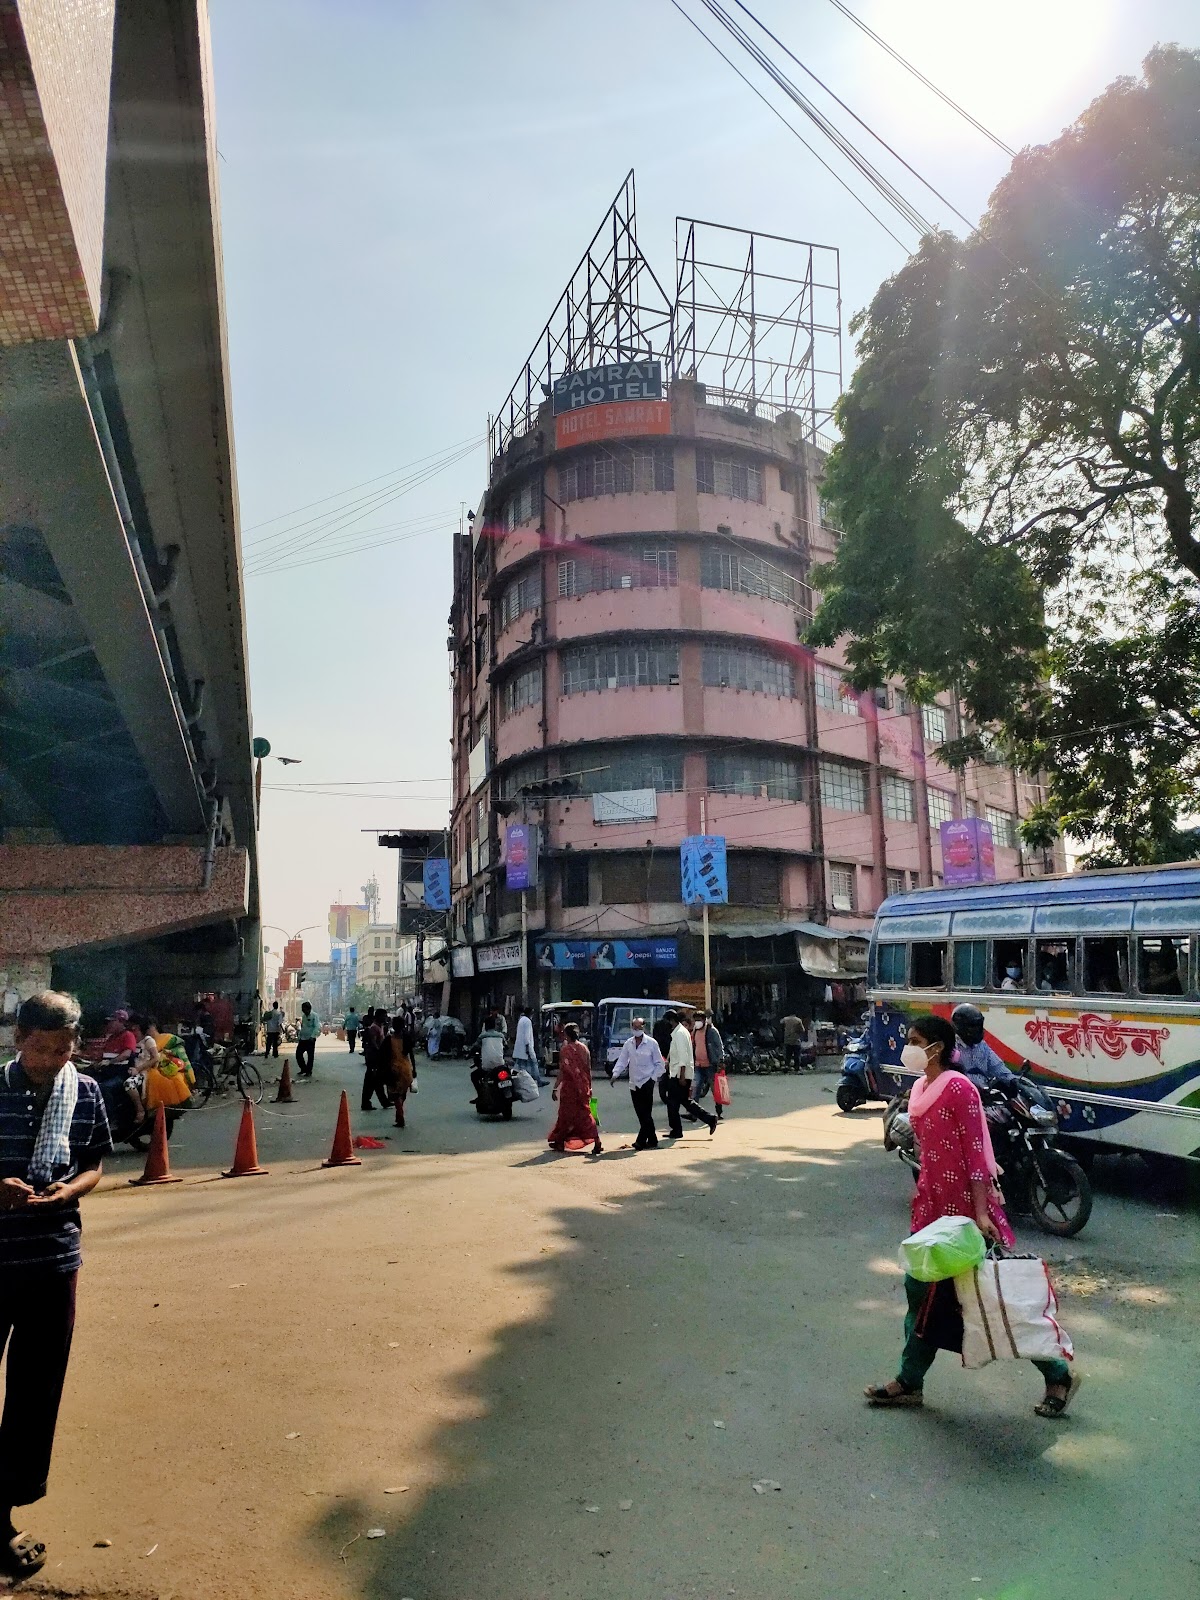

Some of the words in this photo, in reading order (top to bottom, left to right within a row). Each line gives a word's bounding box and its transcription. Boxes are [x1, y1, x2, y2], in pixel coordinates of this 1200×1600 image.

[556, 363, 658, 394] SAMRAT
[571, 382, 657, 407] HOTEL
[562, 412, 600, 434] HOTEL
[606, 407, 663, 425] SAMRAT
[634, 952, 652, 960] pepsi
[1024, 1013, 1171, 1066] পারভিন
